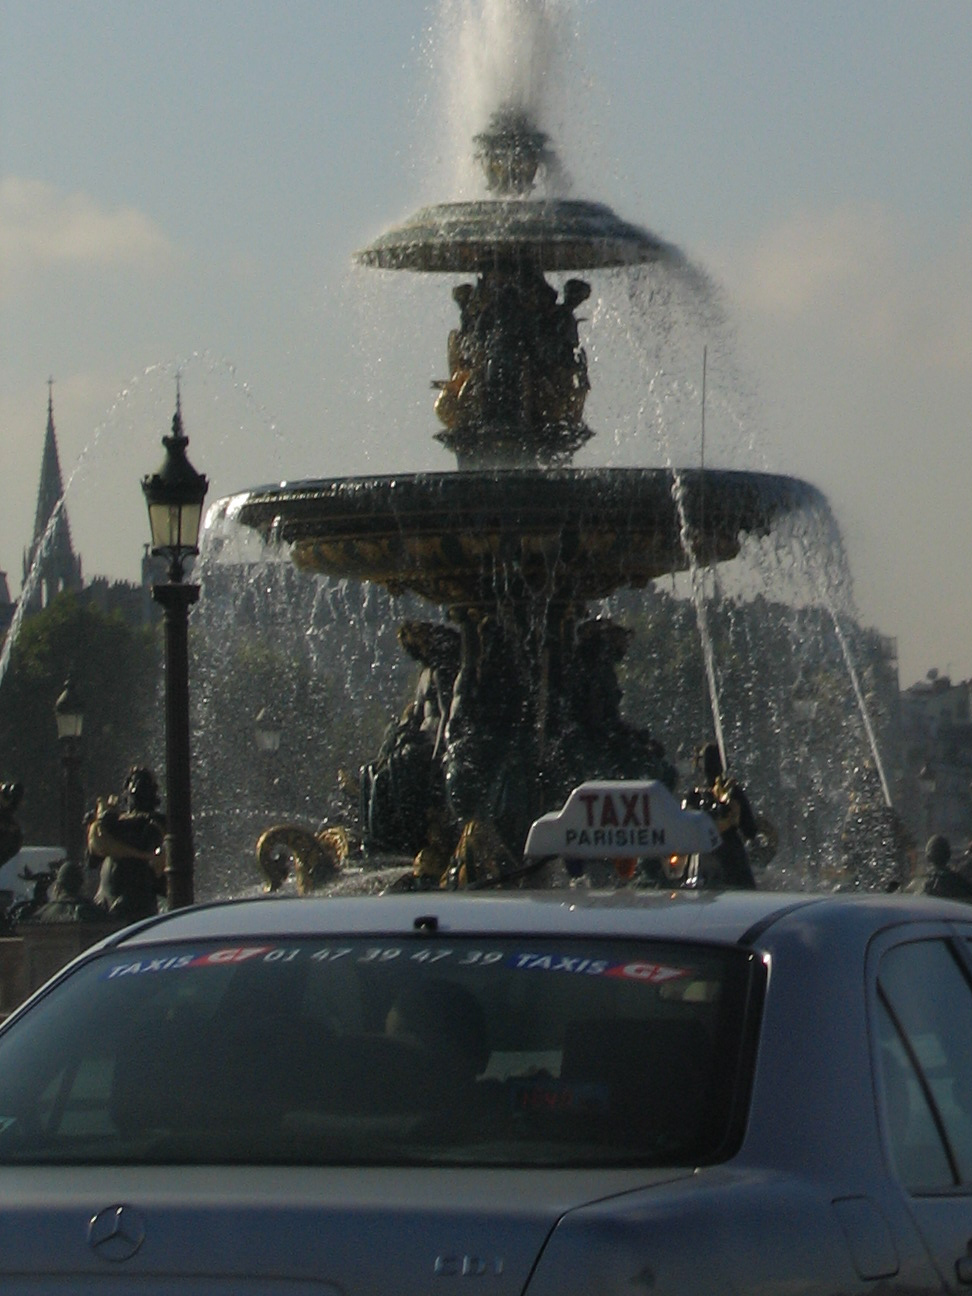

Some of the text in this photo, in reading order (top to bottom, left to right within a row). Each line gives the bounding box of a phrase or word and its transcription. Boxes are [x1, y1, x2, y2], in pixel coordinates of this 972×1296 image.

[579, 793, 652, 827] TAXI
[565, 829, 666, 846] PARISIEN
[107, 947, 684, 983] TAXIS G7 01 47 39 47 39 TAXIS G7
